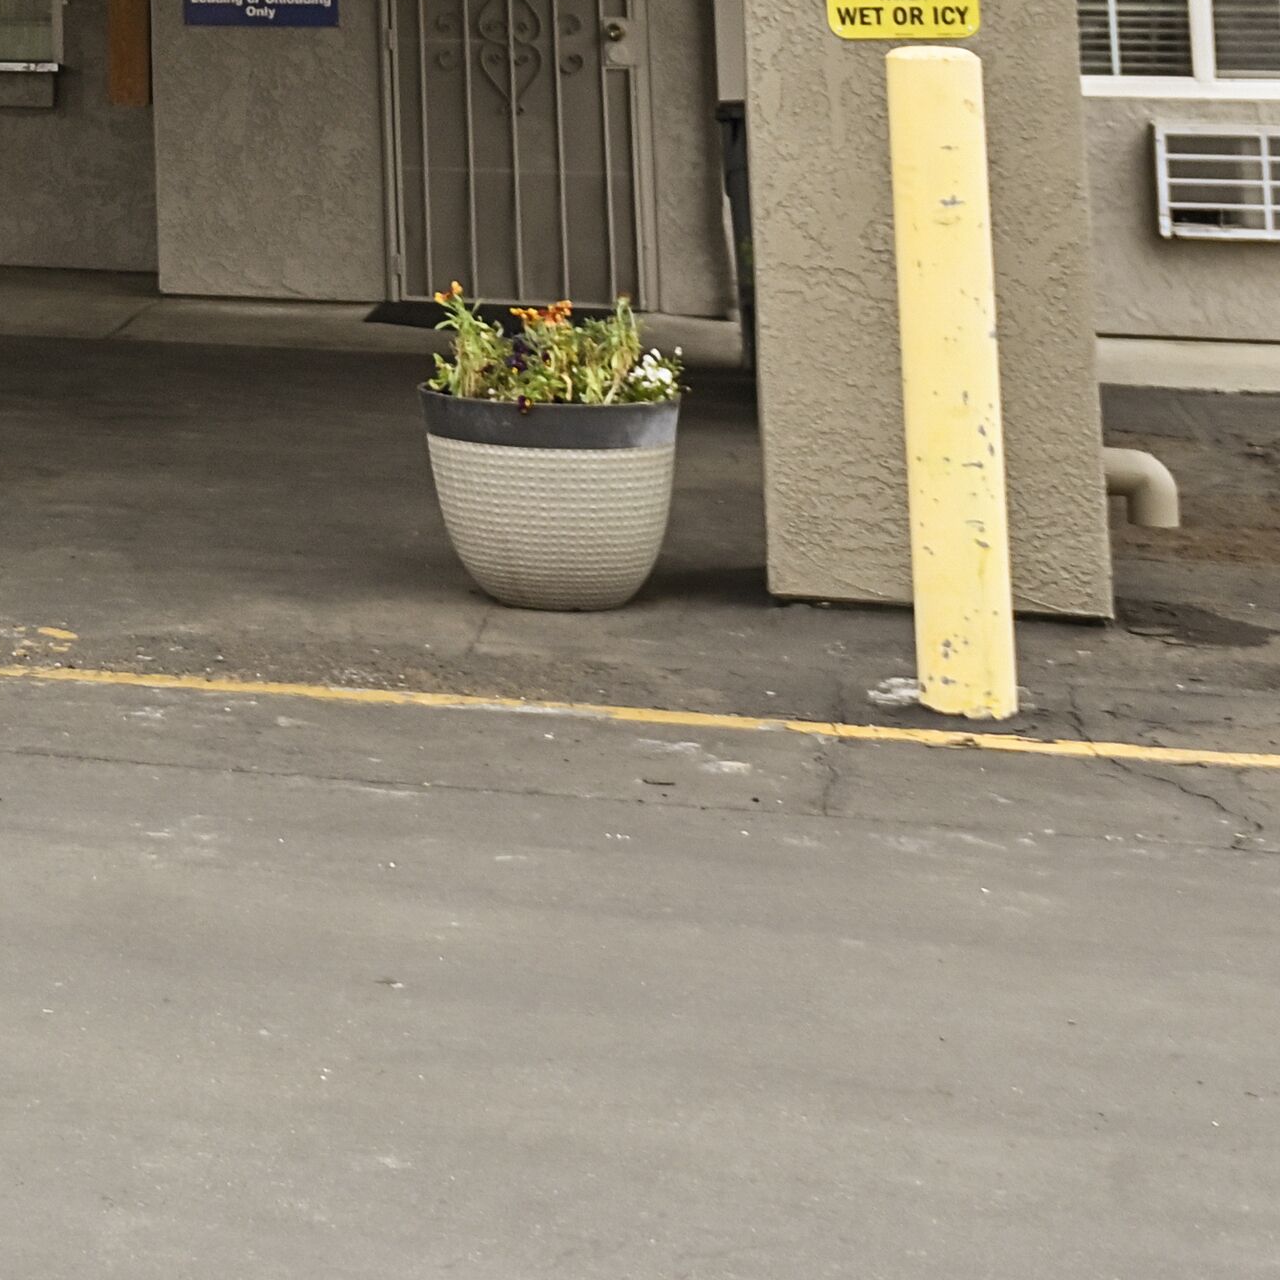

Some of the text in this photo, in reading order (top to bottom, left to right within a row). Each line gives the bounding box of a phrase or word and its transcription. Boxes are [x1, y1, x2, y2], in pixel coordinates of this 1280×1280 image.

[246, 6, 276, 18] Only
[837, 7, 969, 26] WET OR ICY
